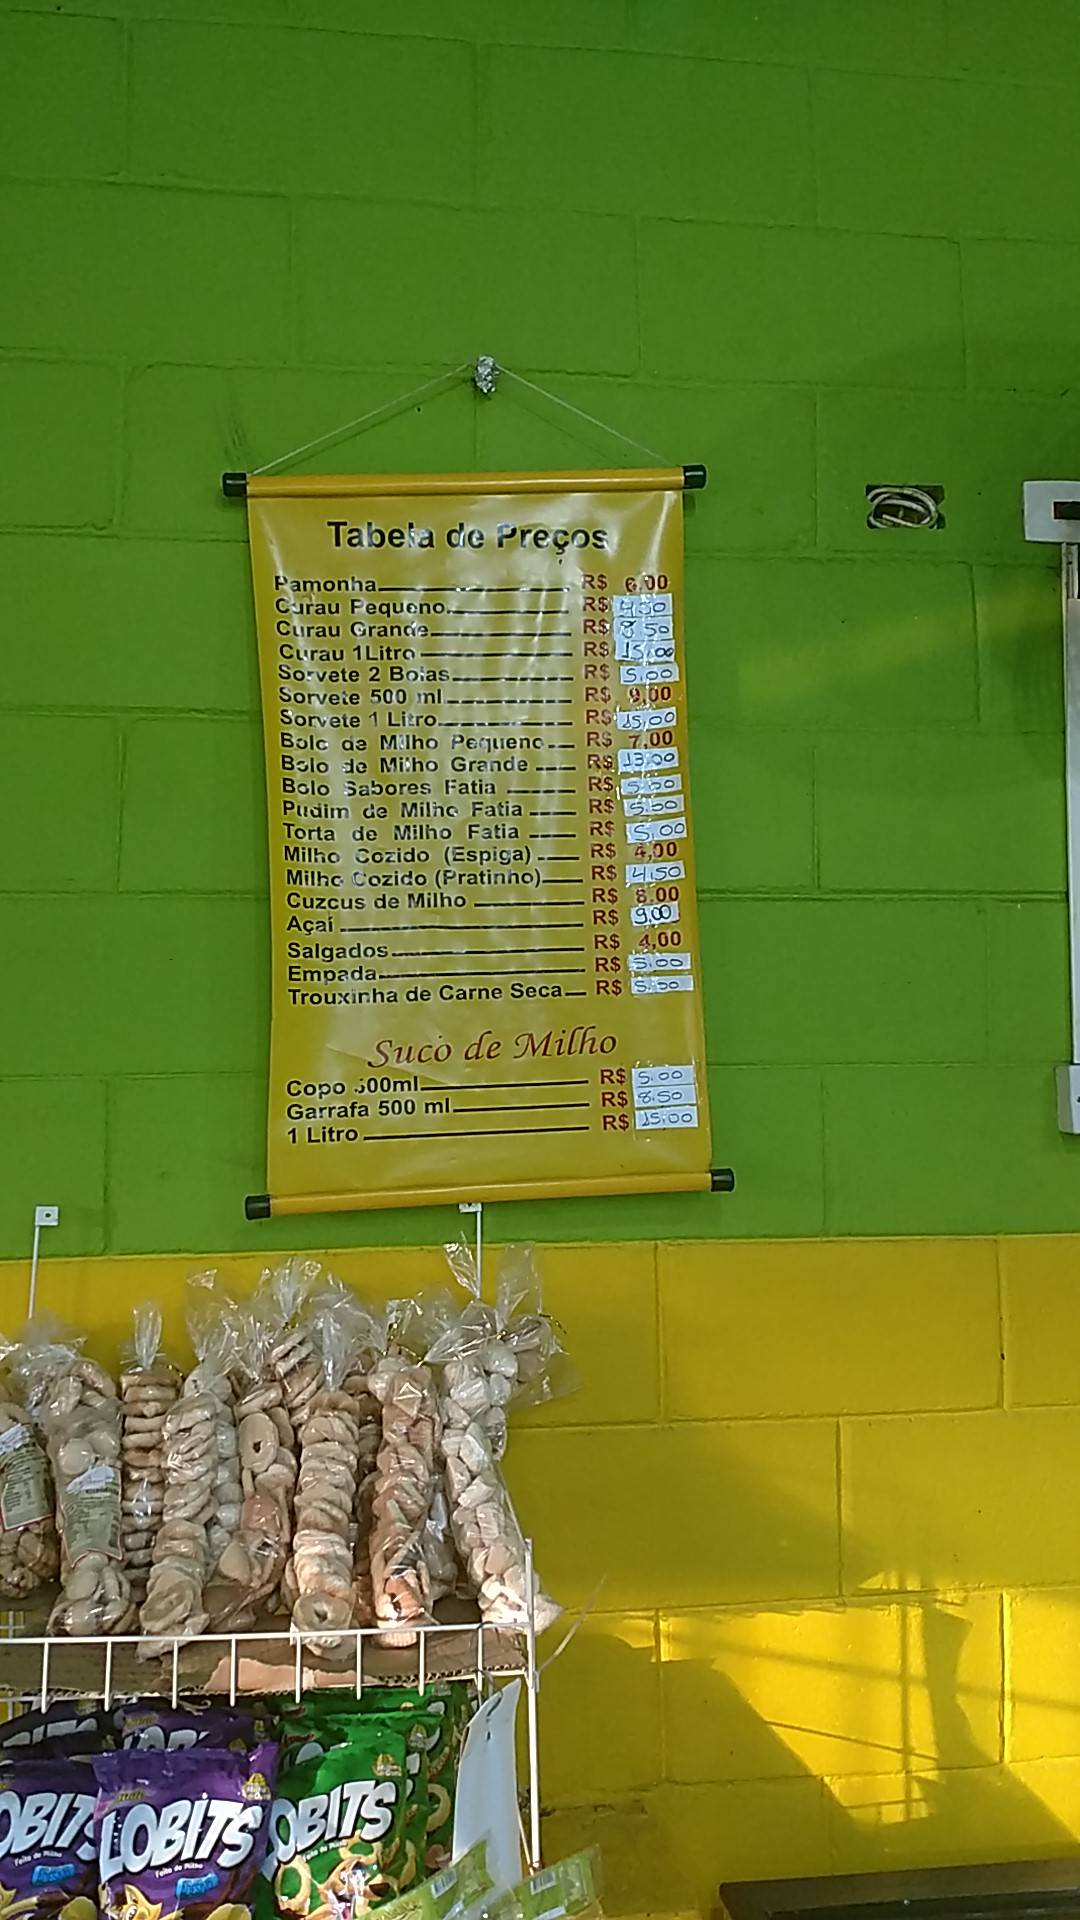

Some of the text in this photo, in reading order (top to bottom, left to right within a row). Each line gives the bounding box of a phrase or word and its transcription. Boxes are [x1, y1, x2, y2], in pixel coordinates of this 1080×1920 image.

[326, 521, 609, 555] Tabela de Preços
[274, 575, 377, 592] Pamonha
[582, 574, 607, 590] R$
[275, 598, 340, 615] Curau
[350, 598, 445, 618] Pequeno
[583, 596, 608, 613] R$
[276, 620, 341, 638] Curau
[350, 620, 429, 638] Grande
[583, 619, 609, 636] R$
[279, 644, 345, 661] Curau
[352, 645, 416, 661] 1Litro
[583, 641, 610, 658] R$
[278, 664, 360, 682] Sorvete
[369, 666, 381, 682] 2
[389, 666, 450, 682] Bolas
[584, 664, 610, 681] R$
[279, 686, 361, 705] Sorvete
[370, 689, 407, 705] 500
[416, 689, 442, 705] ml
[585, 686, 611, 704] R$
[280, 709, 361, 728] Sorvete
[368, 711, 379, 727] 1
[388, 711, 437, 727] Litro
[586, 709, 612, 726] R$
[280, 730, 673, 753] Bolo de Milho Pequeno R$ 7,00
[281, 755, 330, 773] Bolo
[342, 758, 368, 774] de
[380, 757, 439, 773] Milho
[450, 756, 529, 773] Grande
[588, 753, 614, 770] R$
[282, 778, 331, 797] Bolo
[343, 778, 432, 797] Sabores
[444, 779, 496, 795] Fatia
[588, 776, 614, 793] R$
[282, 800, 350, 819] Pudim
[362, 803, 389, 819] de
[401, 802, 459, 818] Milho
[471, 800, 523, 817] Fatia
[589, 798, 615, 815] R$
[282, 822, 336, 841] Torta
[352, 825, 378, 842] de
[393, 824, 453, 841] Milho
[468, 823, 520, 840] Fatia
[590, 820, 616, 838] R$
[283, 842, 678, 866] Milho Cozido (Espiga) R$ 4,00
[286, 869, 344, 887] Milho
[352, 869, 428, 887] Cozido
[434, 868, 542, 889] (Pratinho)
[591, 864, 617, 881] R$
[286, 892, 367, 910] Cuzcus
[373, 893, 401, 910] de
[407, 892, 467, 909] Milho
[592, 888, 619, 905] R$
[286, 915, 334, 936] Açaí
[593, 909, 619, 926] R$
[287, 931, 682, 963] Salgados R$ 4,00
[288, 965, 377, 986] Empada
[595, 956, 621, 973] R$
[288, 986, 399, 1005] Trouxinha
[405, 986, 432, 1002] de
[438, 984, 503, 1000] Carne
[510, 982, 563, 998] Seca
[596, 979, 623, 997] R$
[367, 1025, 617, 1068] Suco de Milho
[286, 1080, 346, 1099] Copo
[600, 1068, 627, 1086] R$
[286, 1101, 370, 1121] Garrafa
[378, 1099, 416, 1116] 500
[424, 1097, 450, 1114] ml
[601, 1090, 629, 1108] R$
[287, 1127, 297, 1144] 1
[307, 1126, 359, 1143] Litro
[602, 1113, 630, 1132] R$
[99, 1799, 263, 1884] LOBITS
[155, 1866, 173, 1879] Feito
[174, 1864, 183, 1872] de
